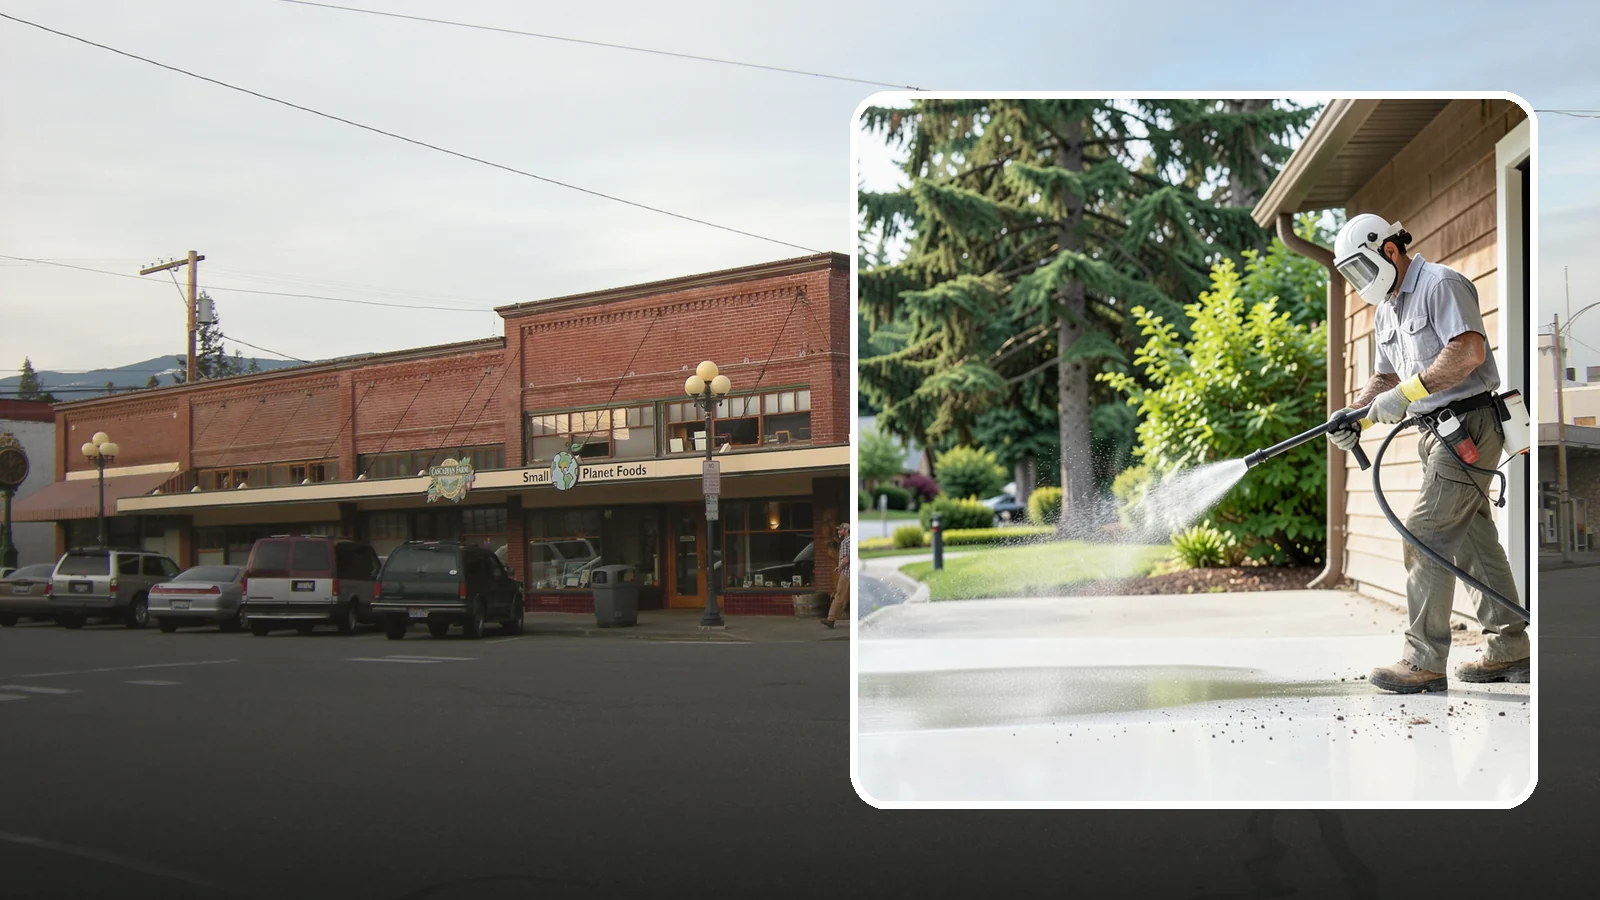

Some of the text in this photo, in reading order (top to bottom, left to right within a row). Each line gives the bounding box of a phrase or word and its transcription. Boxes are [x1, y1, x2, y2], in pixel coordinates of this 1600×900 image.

[523, 464, 647, 483] Small Planet Foods
